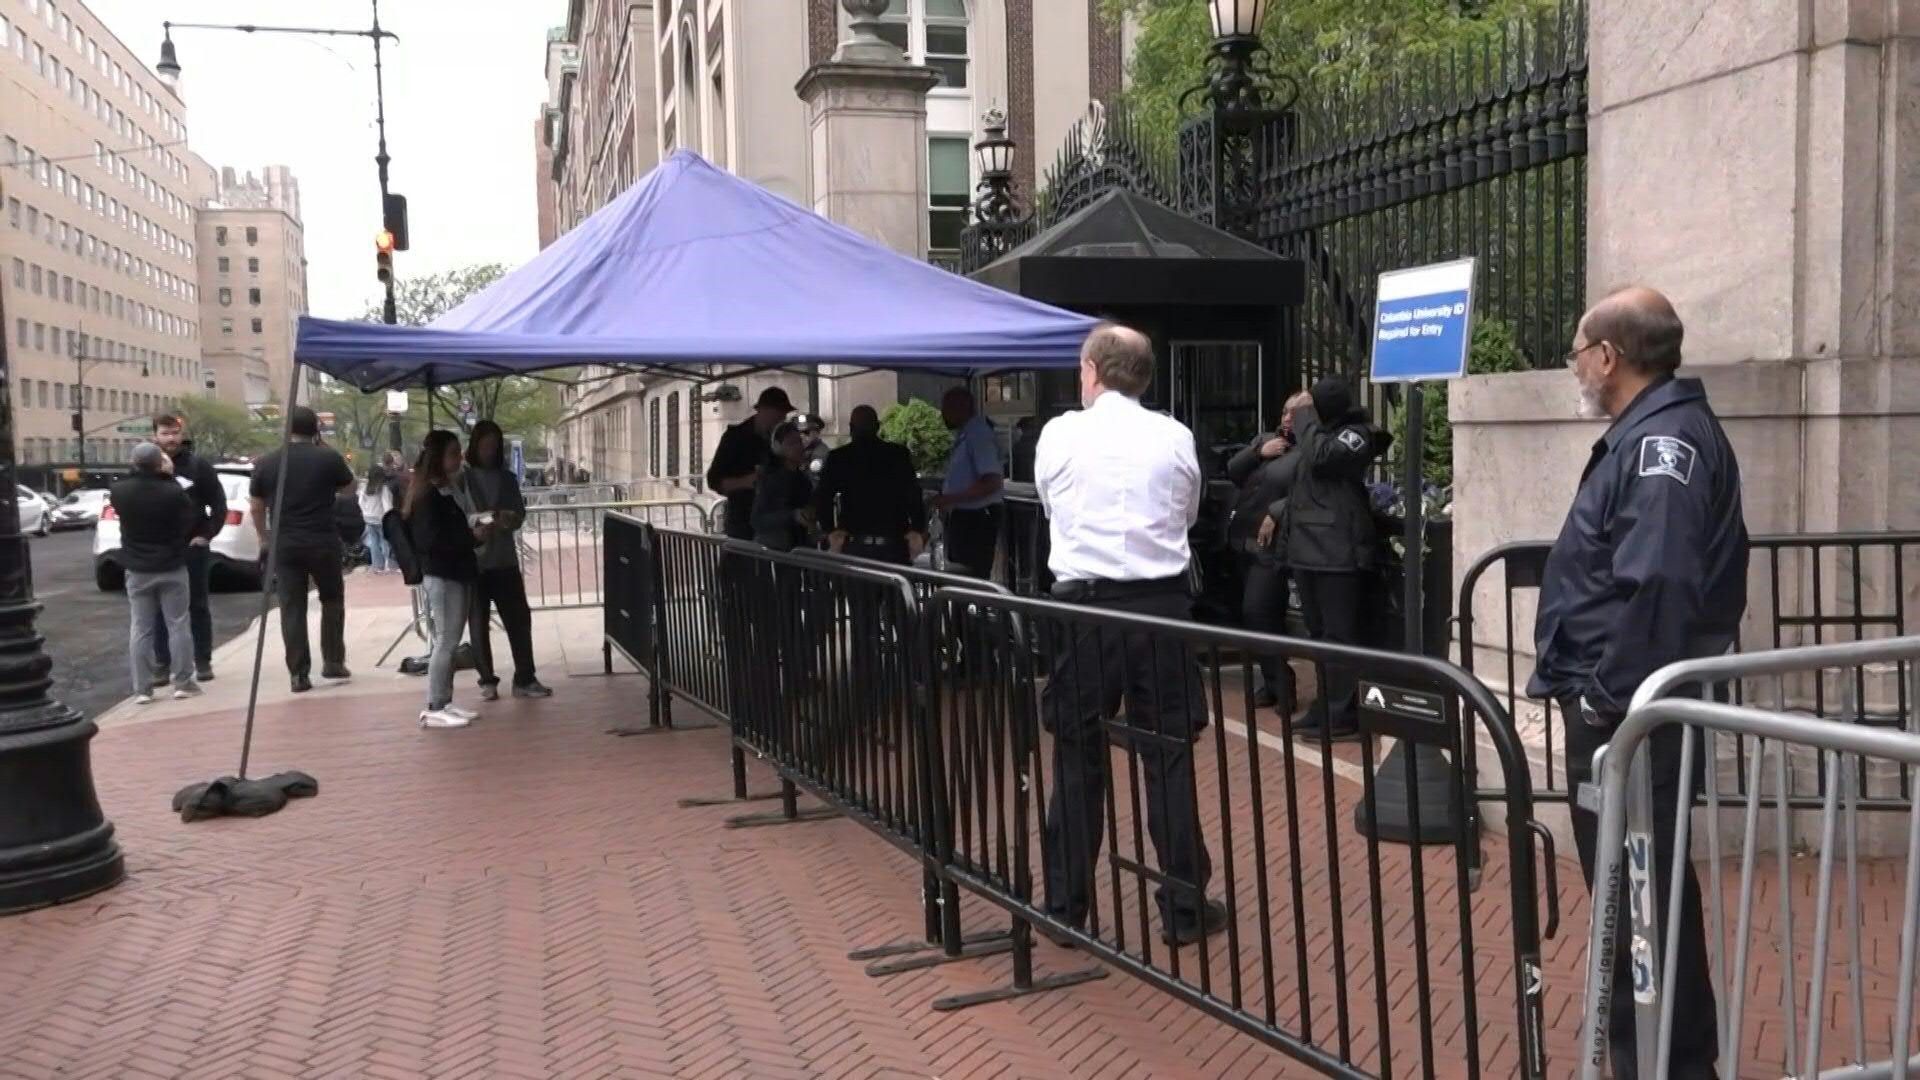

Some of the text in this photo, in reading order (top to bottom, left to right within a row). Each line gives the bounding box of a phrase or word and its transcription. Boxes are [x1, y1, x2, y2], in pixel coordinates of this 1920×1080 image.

[1381, 302, 1465, 323] Columbia University ID
[1379, 324, 1444, 340] Required for Entry
